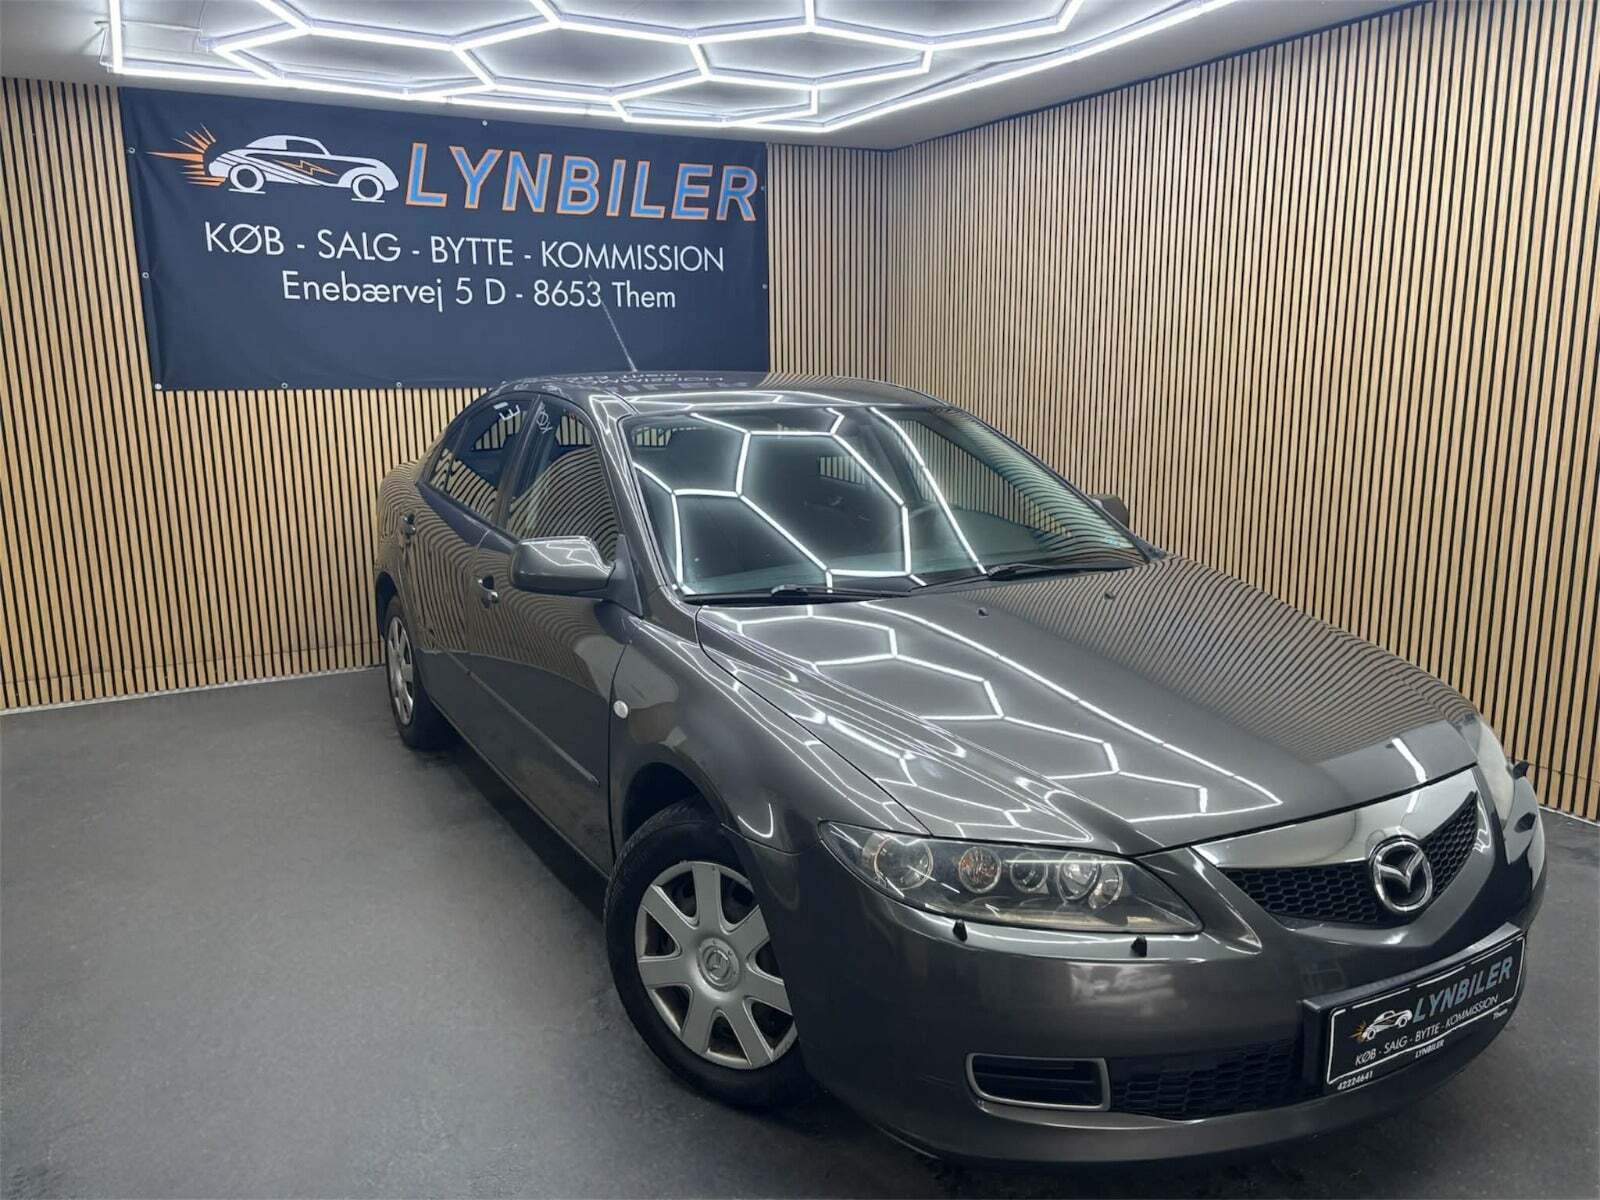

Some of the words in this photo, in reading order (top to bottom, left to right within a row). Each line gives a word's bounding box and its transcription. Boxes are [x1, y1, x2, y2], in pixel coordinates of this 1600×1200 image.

[404, 141, 759, 222] LYNBILER
[204, 221, 284, 256] KØB
[317, 228, 401, 262] SALG
[430, 235, 514, 266] BYTTE
[541, 240, 724, 272] KOMMISSION
[282, 269, 443, 313] Enebærvej
[455, 277, 473, 305] 5
[485, 278, 506, 305] D
[533, 279, 601, 307] 8653
[611, 279, 676, 308] Them
[1412, 955, 1513, 1024] LYNBILER
[1355, 1048, 1377, 1067] KØB
[1383, 1035, 1408, 1054] SALG
[1415, 1022, 1441, 1042] BYTTE
[1445, 993, 1499, 1030] KOMMISSION
[1415, 1039, 1445, 1058] LYNBILER
